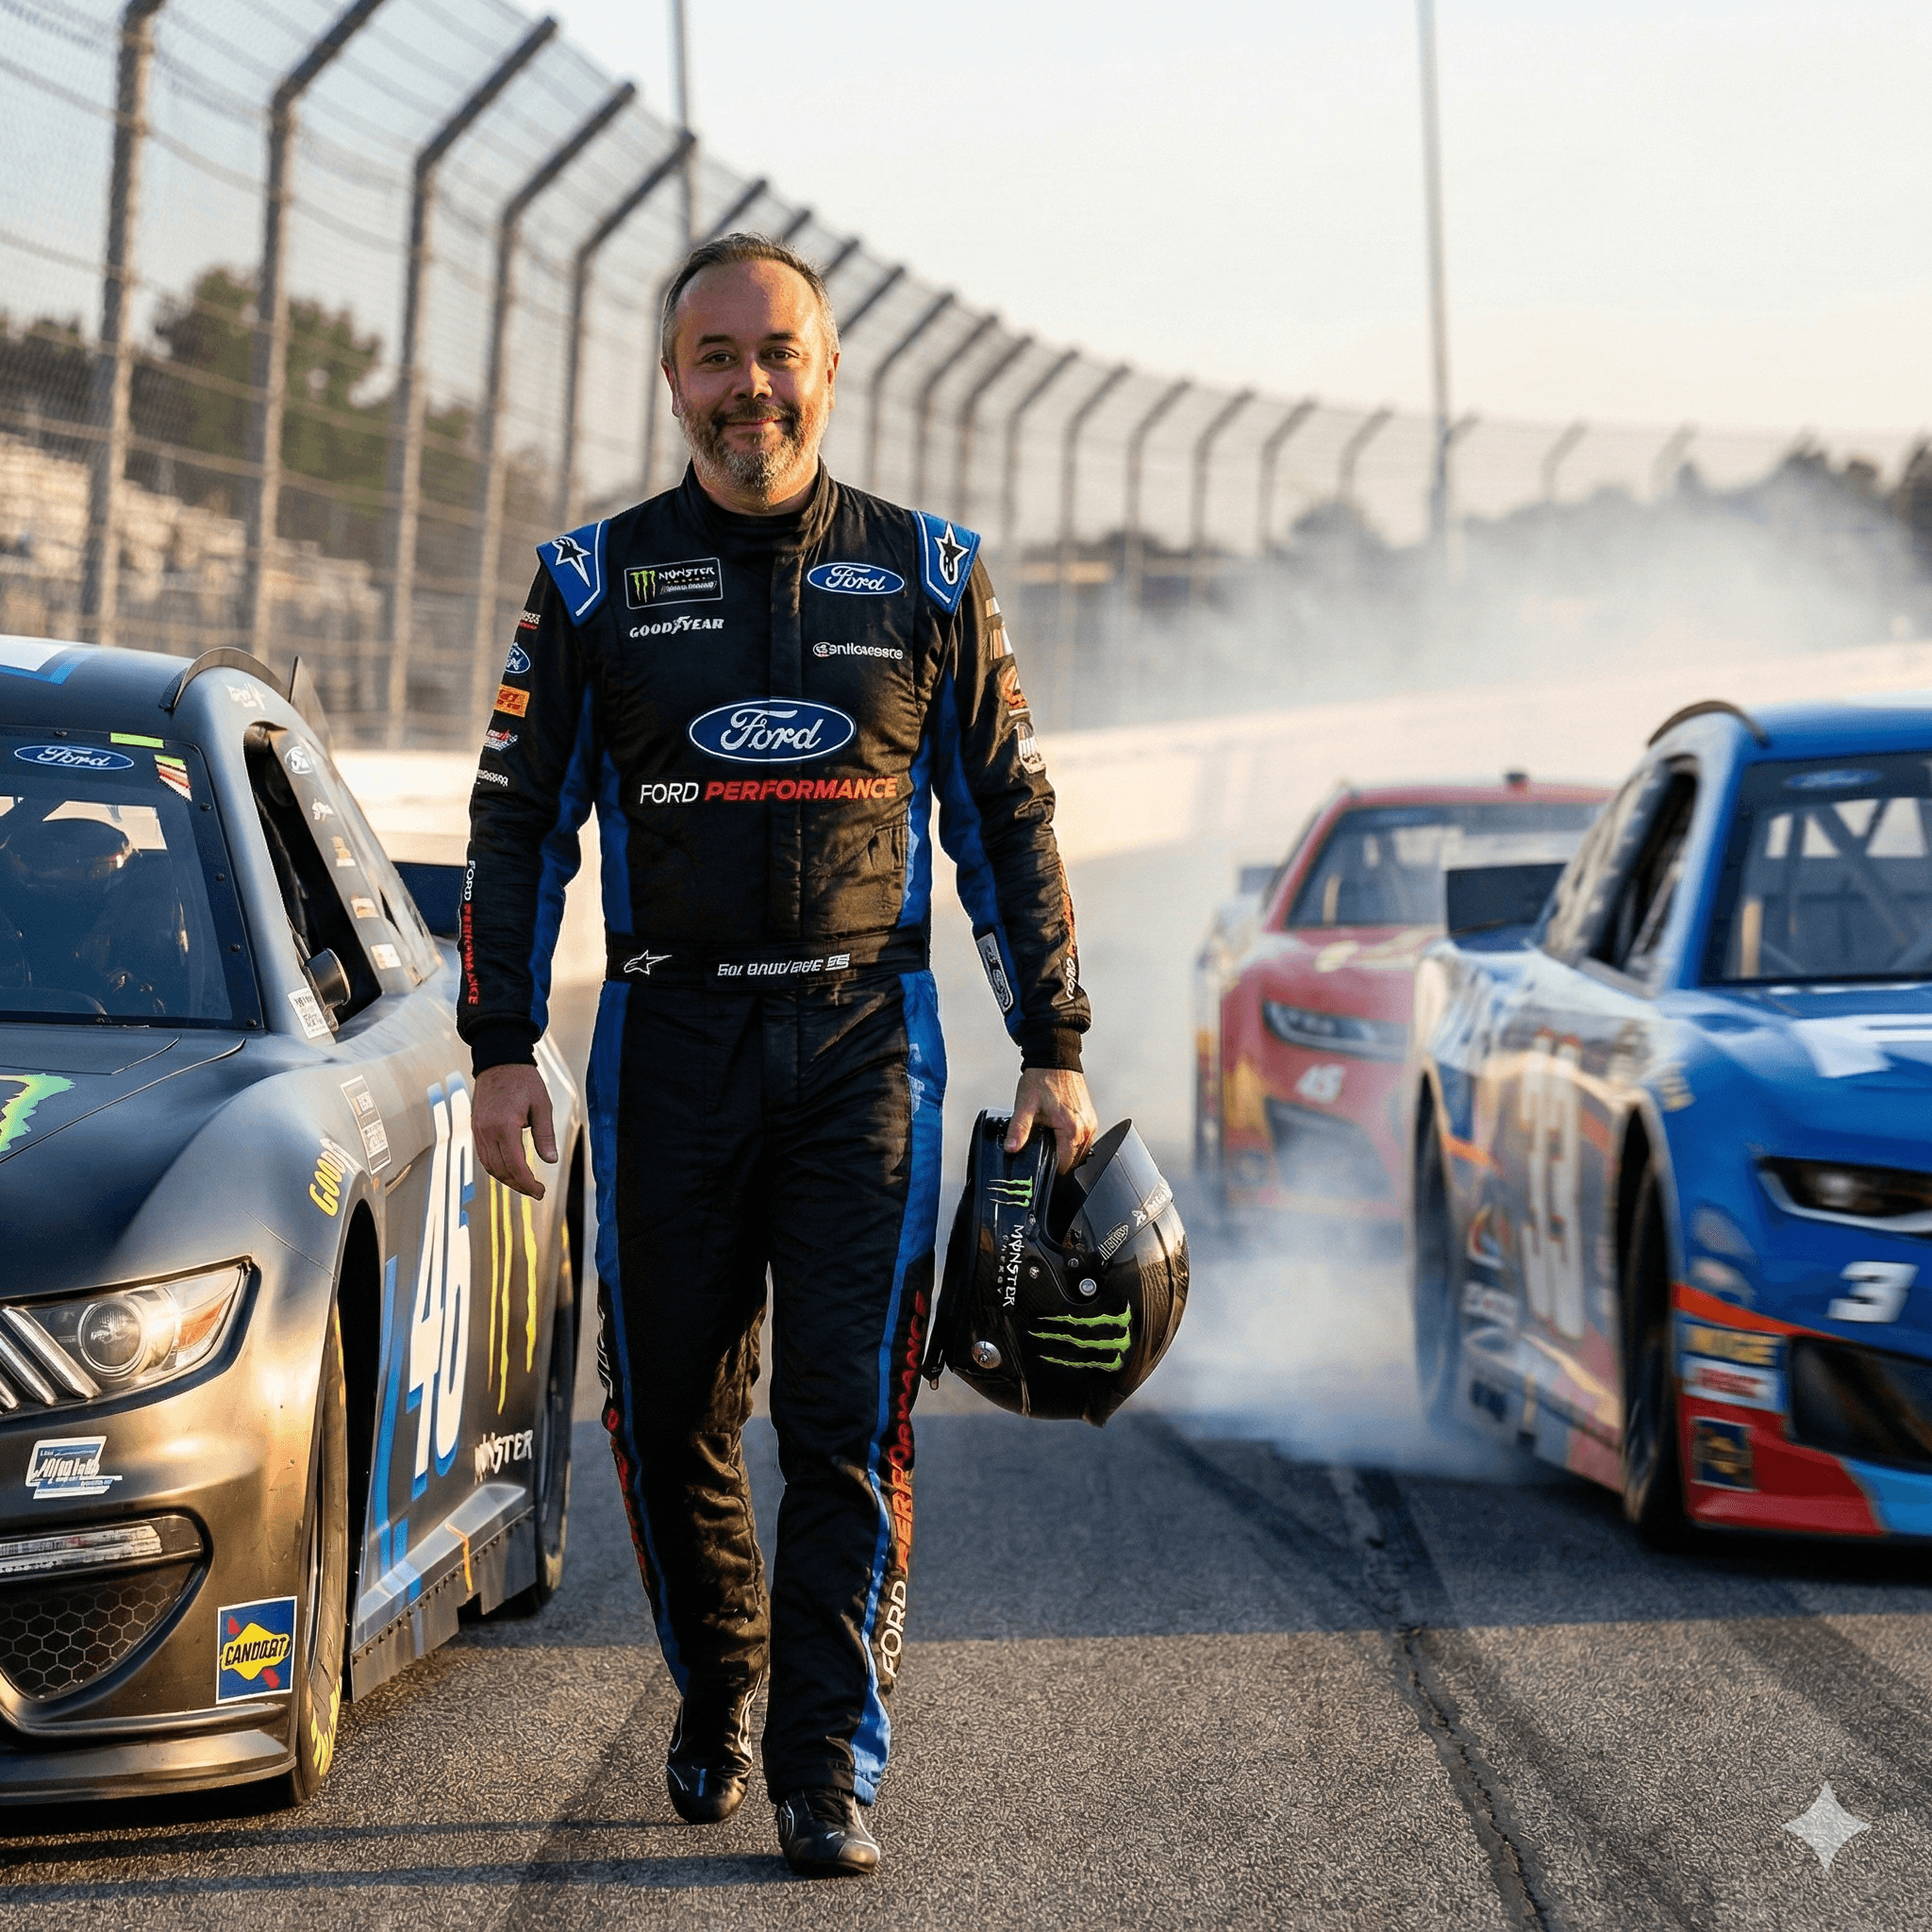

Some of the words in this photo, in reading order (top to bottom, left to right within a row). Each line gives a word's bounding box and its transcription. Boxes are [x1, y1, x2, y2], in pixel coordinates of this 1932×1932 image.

[825, 566, 886, 591] Ford
[629, 615, 724, 639] GOODYEAR
[720, 708, 824, 751] Ford
[37, 746, 111, 767] Ford
[640, 782, 699, 804] FORD
[704, 776, 898, 801] PERFORMANCE
[1827, 1261, 1919, 1323] 3
[880, 1580, 907, 1678] FORD
